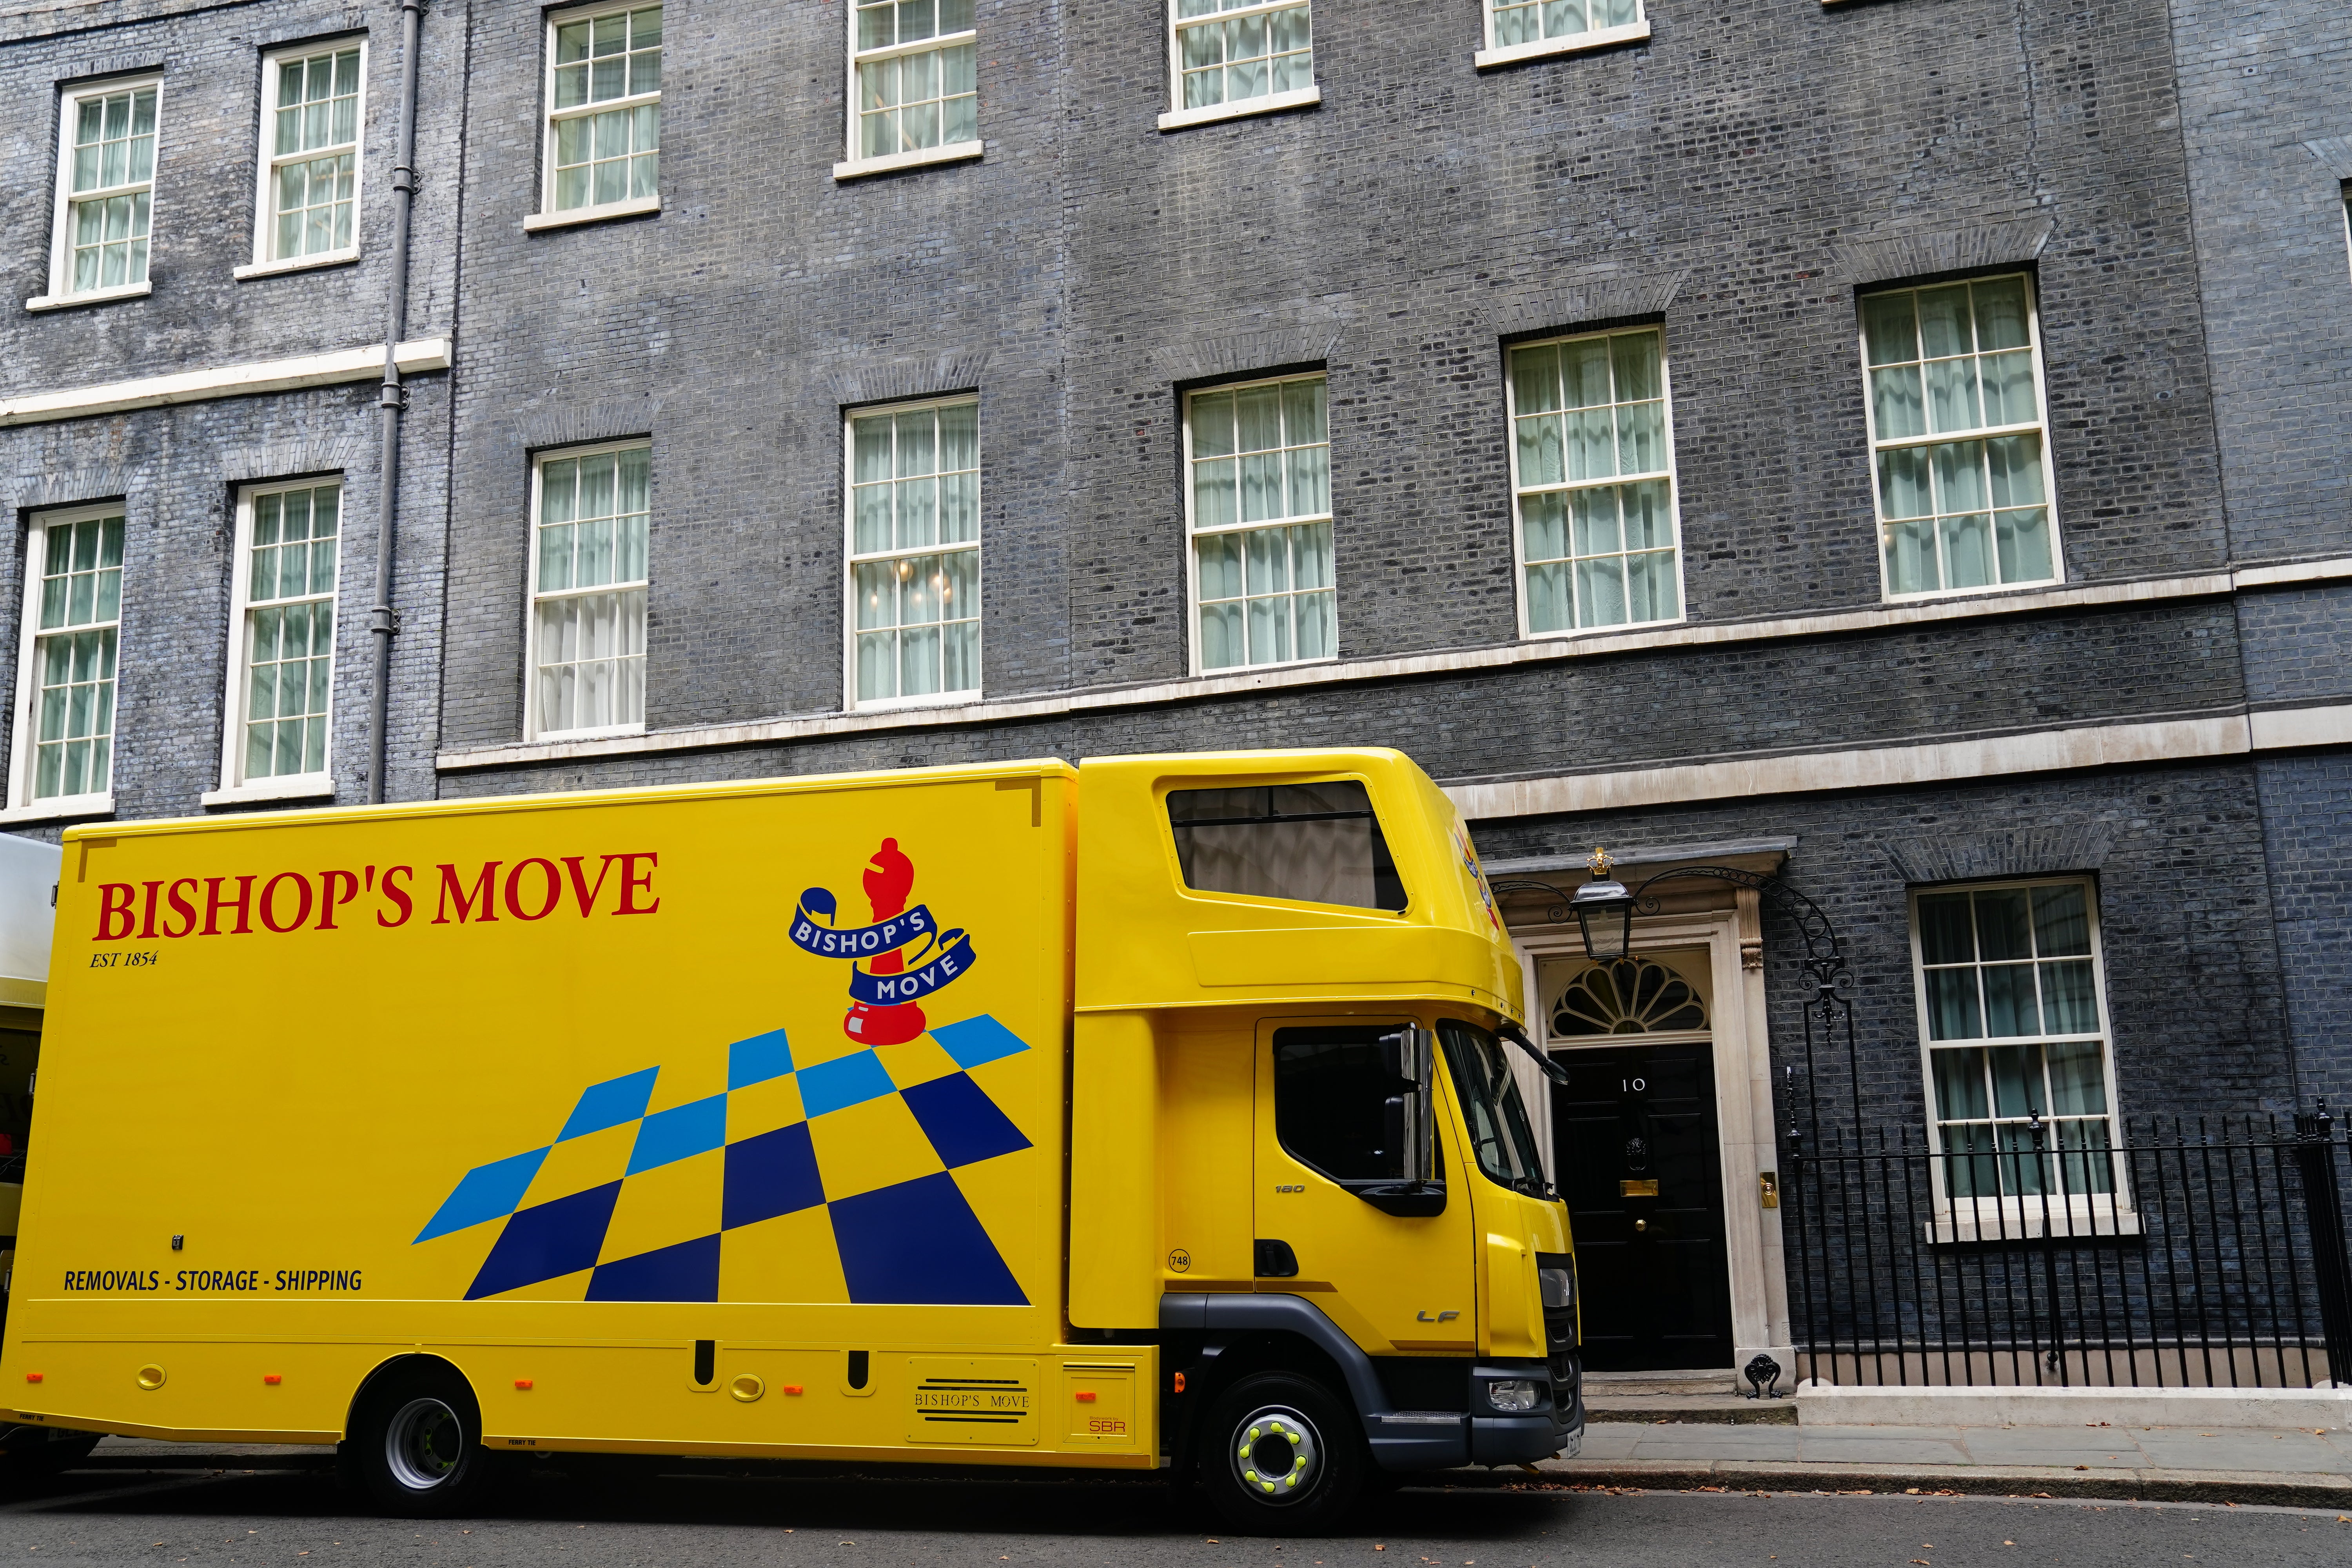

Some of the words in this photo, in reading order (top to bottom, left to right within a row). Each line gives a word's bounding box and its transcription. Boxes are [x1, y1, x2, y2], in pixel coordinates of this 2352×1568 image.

[93, 864, 413, 941] BISHOP'S
[430, 852, 661, 924] MOVE
[795, 911, 925, 953] BISHOP'S
[89, 953, 121, 968] EST
[123, 951, 159, 967] 1854
[877, 955, 958, 999] MOVE
[1623, 1078, 1646, 1092] 10
[1171, 1256, 1188, 1266] 748
[64, 1270, 160, 1291] REMOVALS
[175, 1270, 259, 1291] STORAGE
[274, 1270, 362, 1291] SHIPPING
[1417, 1310, 1460, 1322] LF
[915, 1394, 980, 1406] BISHOP'S
[990, 1395, 1030, 1408] MOVE
[1090, 1421, 1125, 1432] SBR
